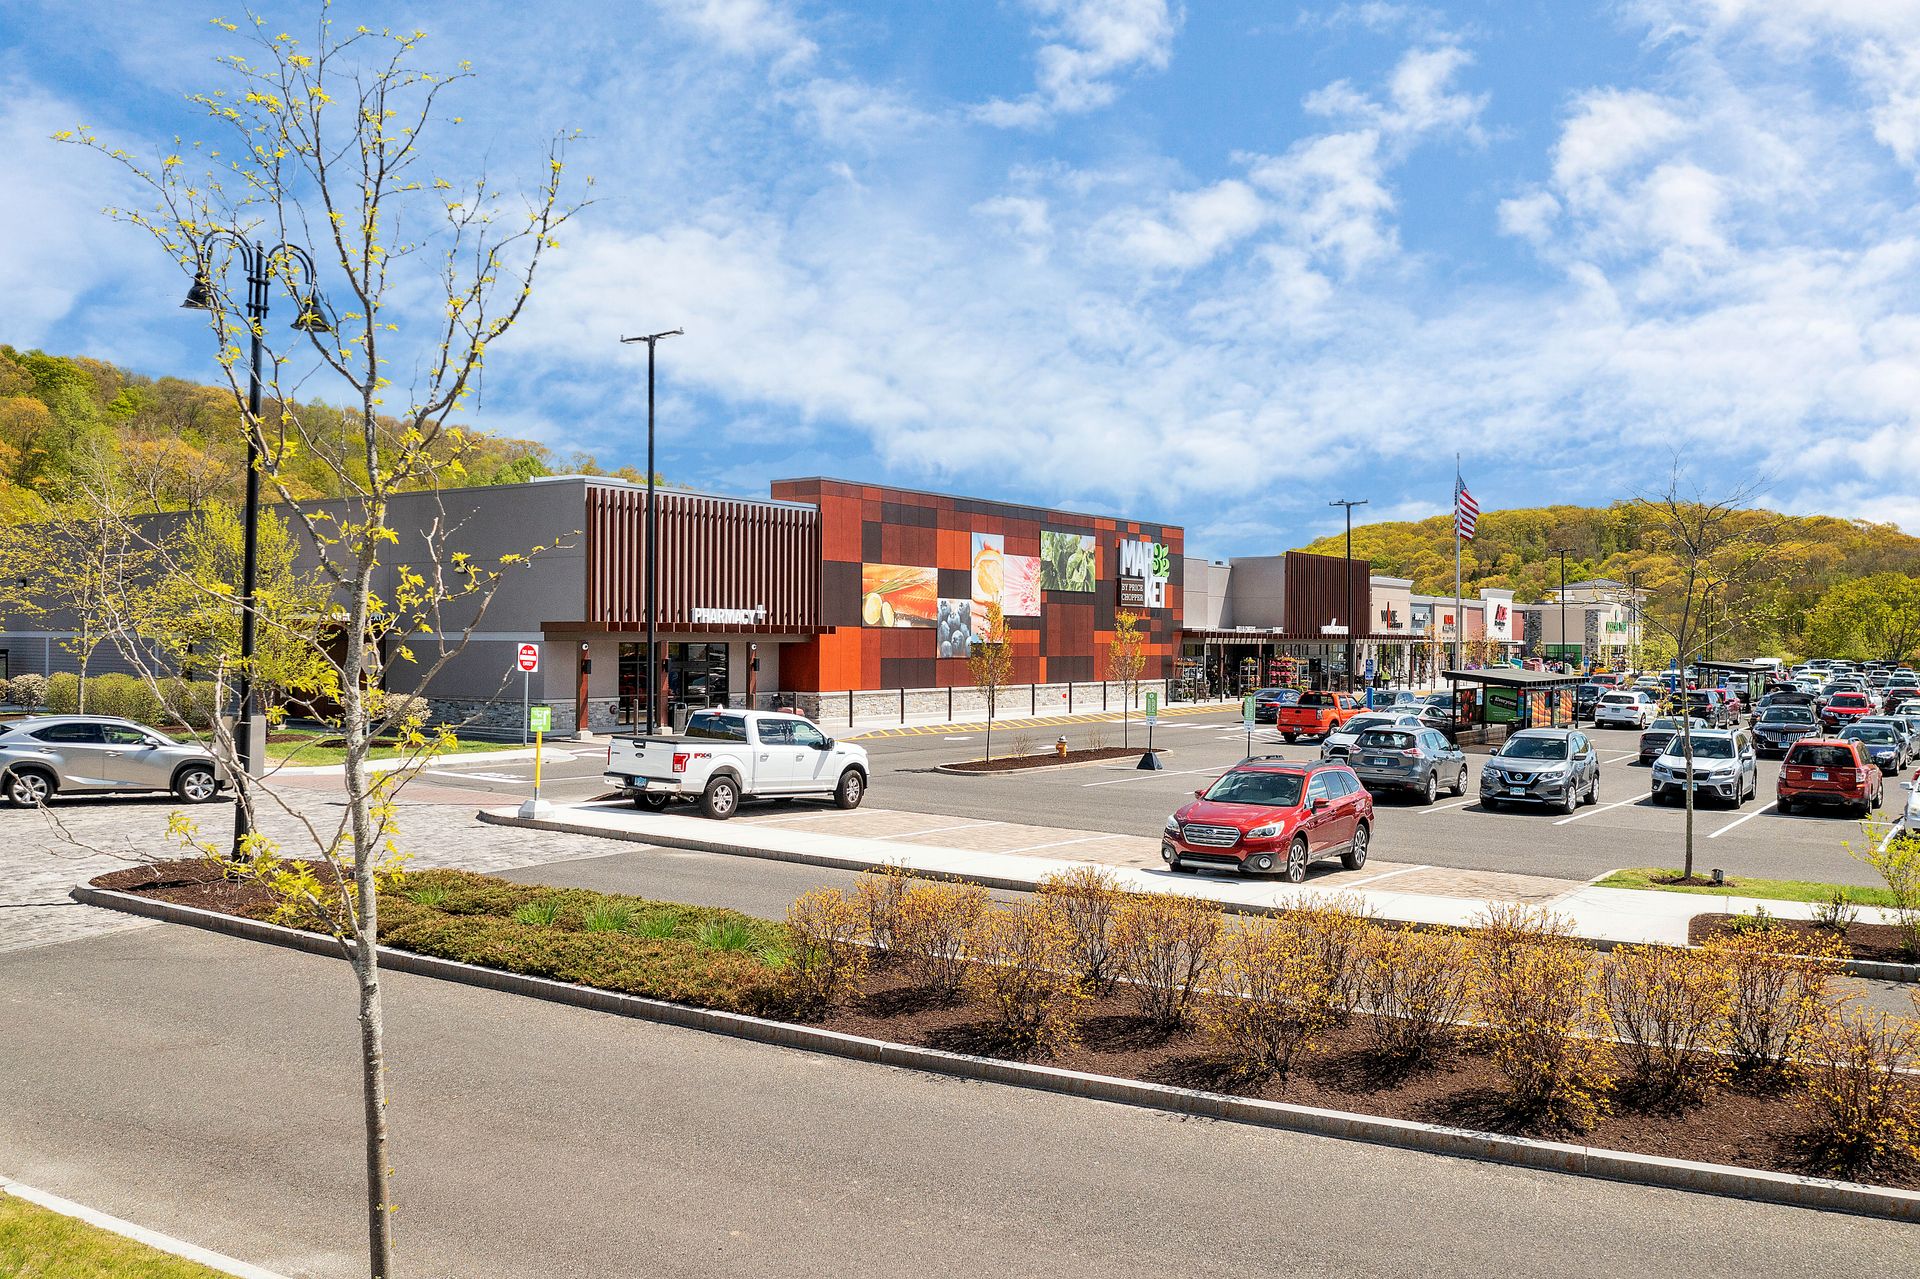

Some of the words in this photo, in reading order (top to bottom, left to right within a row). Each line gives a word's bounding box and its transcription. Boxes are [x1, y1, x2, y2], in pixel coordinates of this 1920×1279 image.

[1121, 583, 1128, 591] BY
[1128, 583, 1143, 592] PRICE
[1121, 593, 1143, 602] CHOPPER
[692, 607, 756, 625] PHARMACY
